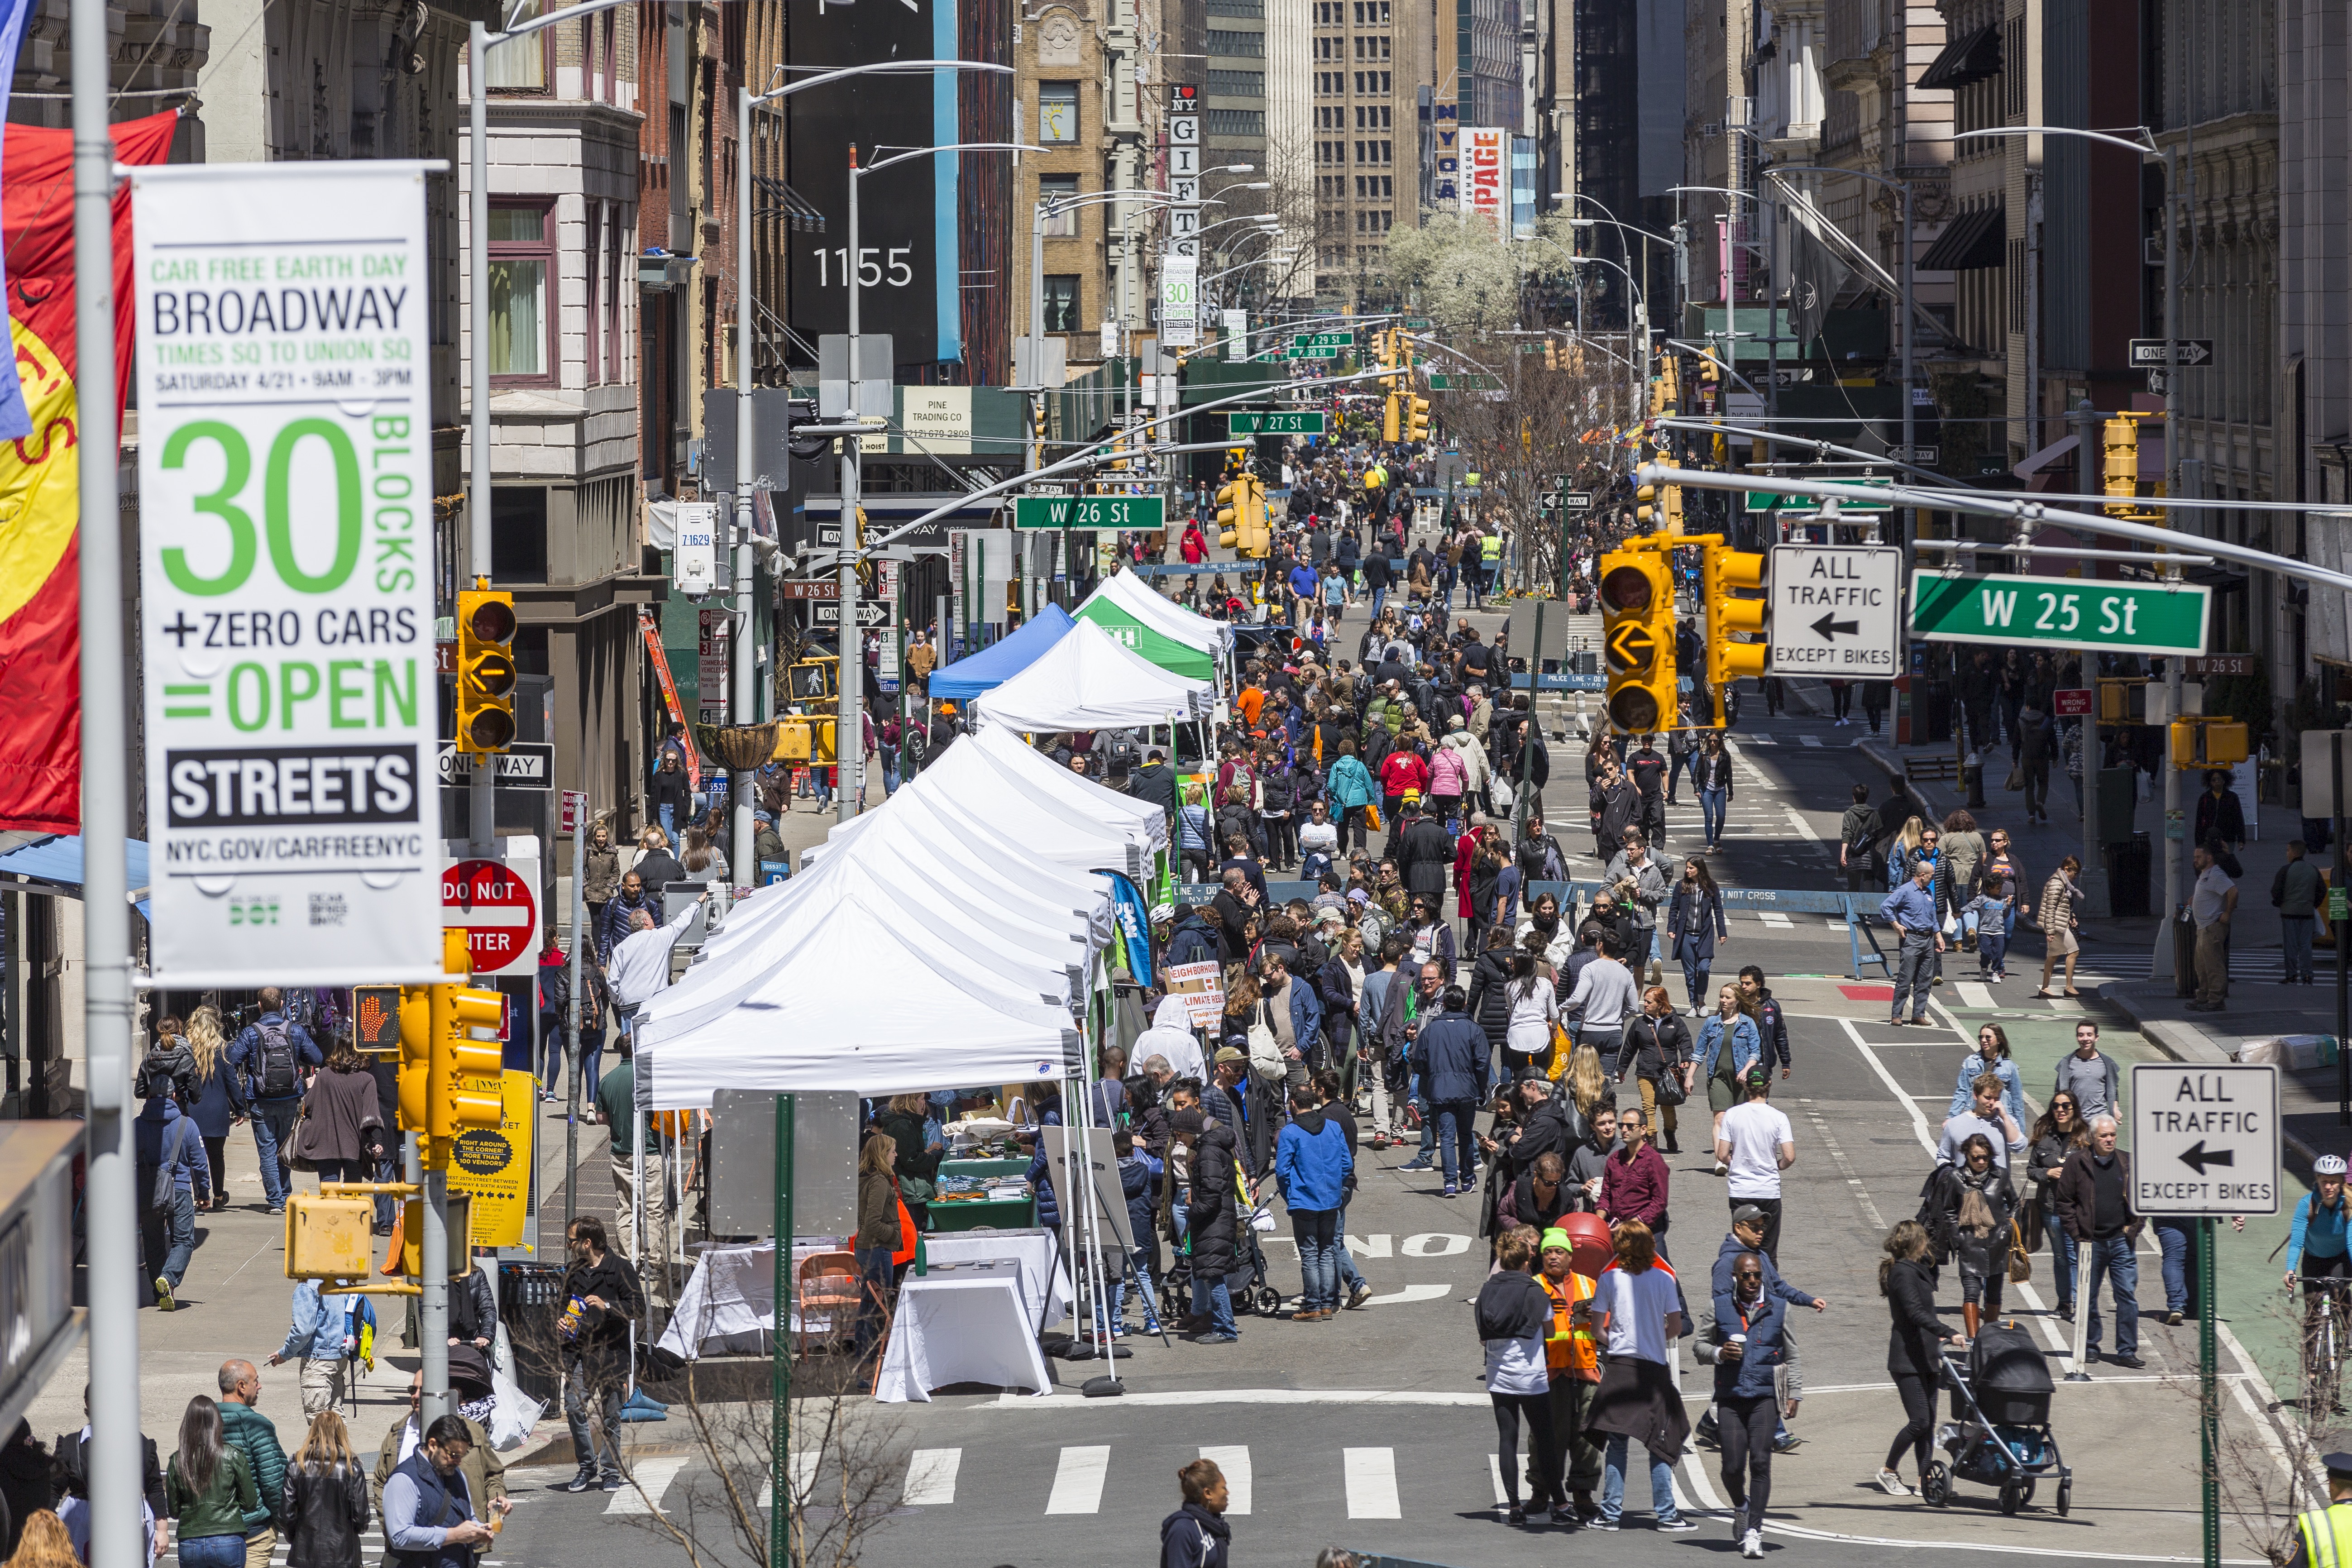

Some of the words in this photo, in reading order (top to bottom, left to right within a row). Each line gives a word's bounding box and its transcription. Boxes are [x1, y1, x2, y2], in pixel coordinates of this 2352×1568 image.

[1174, 87, 1181, 98] I
[1174, 120, 1196, 257] GIFTS
[151, 257, 200, 284] CAR
[209, 256, 266, 282] FREE
[275, 253, 353, 280] EARTH
[363, 252, 407, 277] DAY
[814, 248, 912, 287] 1155
[1166, 283, 1188, 303] 30
[153, 287, 407, 335] BROADWAY
[1319, 336, 1329, 344] 29
[1332, 335, 1340, 344] St
[156, 342, 223, 366] TIMES
[231, 340, 260, 365] SQ
[272, 340, 296, 362] TO
[306, 339, 373, 362] UNION
[382, 337, 411, 361] SQ
[2143, 348, 2166, 358] ONE
[2177, 348, 2201, 358] WAY
[156, 372, 249, 392] SATURDAY
[256, 371, 295, 390] 4/21
[313, 370, 351, 388] 9AM
[373, 369, 411, 387] 3PM
[928, 401, 947, 409] PINE
[913, 413, 948, 421] TRADING
[950, 413, 961, 421] CO
[1252, 416, 1263, 430] W
[1270, 416, 1284, 430] 27
[1290, 416, 1302, 430] St
[160, 416, 363, 597] 30
[371, 415, 415, 593] BLOCKS
[1050, 503, 1067, 523] W
[1078, 502, 1101, 523] 26
[1110, 502, 1129, 523] St
[1811, 556, 1861, 579] ALL
[794, 585, 803, 596] W
[808, 585, 820, 596] 26
[824, 584, 835, 596] St
[881, 585, 886, 594] 3
[1788, 586, 1882, 607] TRAFFIC
[954, 597, 958, 605] 6
[856, 609, 879, 619] WAY
[1982, 589, 2018, 627] W
[2034, 592, 2080, 632] 25
[2098, 596, 2138, 635] St
[163, 609, 300, 649] +ZERO
[317, 607, 417, 646] CARS
[882, 633, 887, 642] 6
[702, 642, 708, 655] 3
[1776, 647, 1837, 663] EXCEPT
[1845, 649, 1891, 664] BIKES
[1915, 655, 1922, 664] P
[2196, 659, 2207, 672] W
[2212, 659, 2225, 673] 26
[2230, 659, 2242, 673] St
[702, 711, 708, 723] 6
[496, 758, 535, 774] WAY
[171, 754, 412, 818] STREETS
[701, 783, 727, 791] 105537
[563, 795, 569, 803] NO
[167, 834, 422, 862] NYC.GOV/CARFREENYC
[443, 882, 468, 899] DO
[478, 882, 515, 899] NOT
[1173, 886, 1193, 895] LINE
[1206, 886, 1217, 894] DO
[1727, 890, 1744, 899] NOT
[1748, 891, 1776, 900] CROSS
[1170, 964, 1216, 979] NEIGHBORHOOD
[1184, 995, 1211, 1006] LIMATE
[2175, 1076, 2234, 1102] ALL
[2151, 1111, 2259, 1133] TRAFFIC
[2141, 1183, 2210, 1199] EXCEPT
[2219, 1183, 2271, 1200] BIKES
